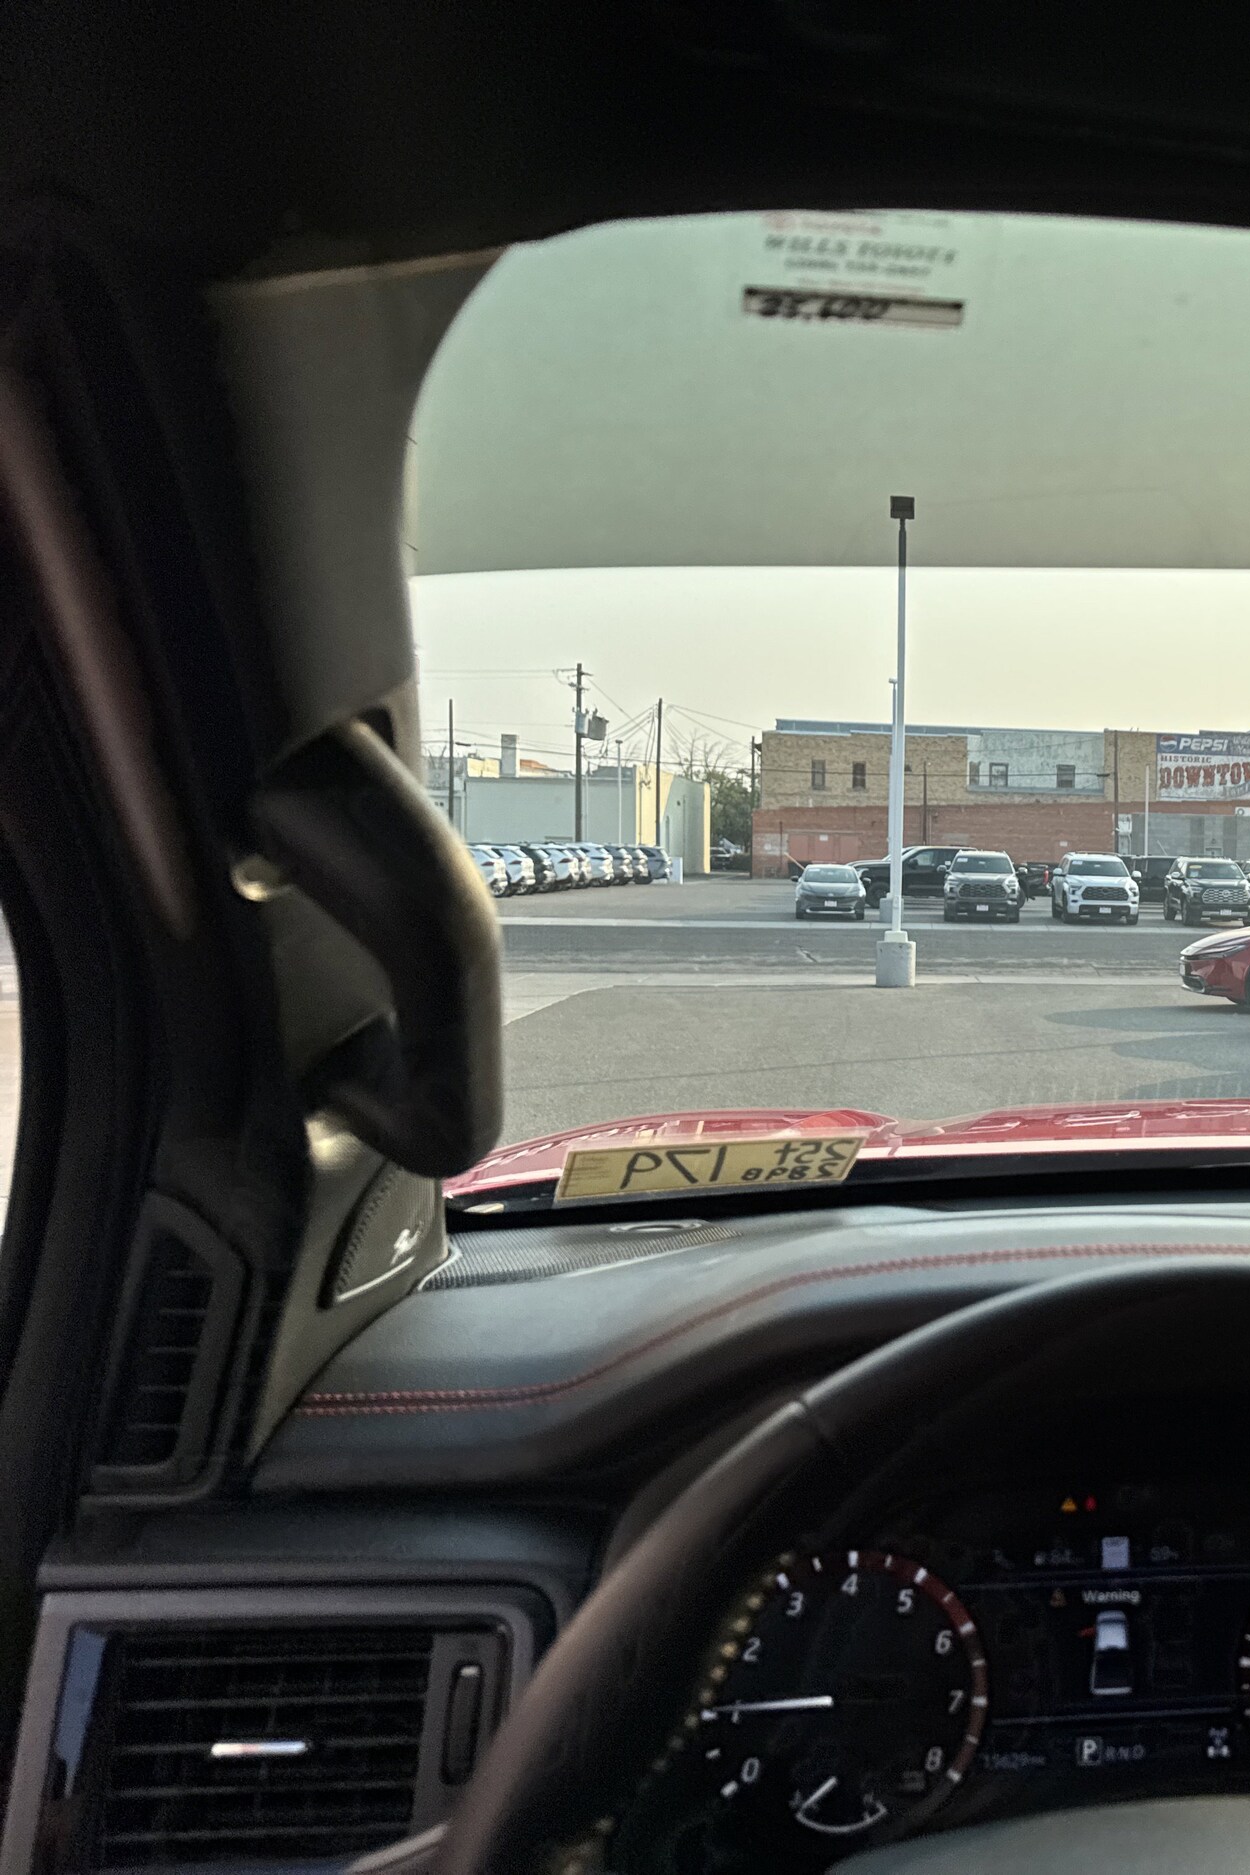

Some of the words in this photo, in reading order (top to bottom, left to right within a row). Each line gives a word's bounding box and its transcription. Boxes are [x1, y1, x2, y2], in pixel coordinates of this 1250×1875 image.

[1179, 737, 1228, 751] PEPSI
[1160, 755, 1212, 763] HISTORIC
[841, 1574, 859, 1596] 4
[1082, 1589, 1141, 1605] Warning
[786, 1592, 804, 1616] 3
[897, 1588, 914, 1613] 5
[742, 1637, 761, 1662] 2
[935, 1630, 953, 1655] 6
[948, 1689, 964, 1714] 7
[925, 1746, 943, 1772] 8
[1082, 1740, 1098, 1761] P
[741, 1757, 761, 1783] 0
